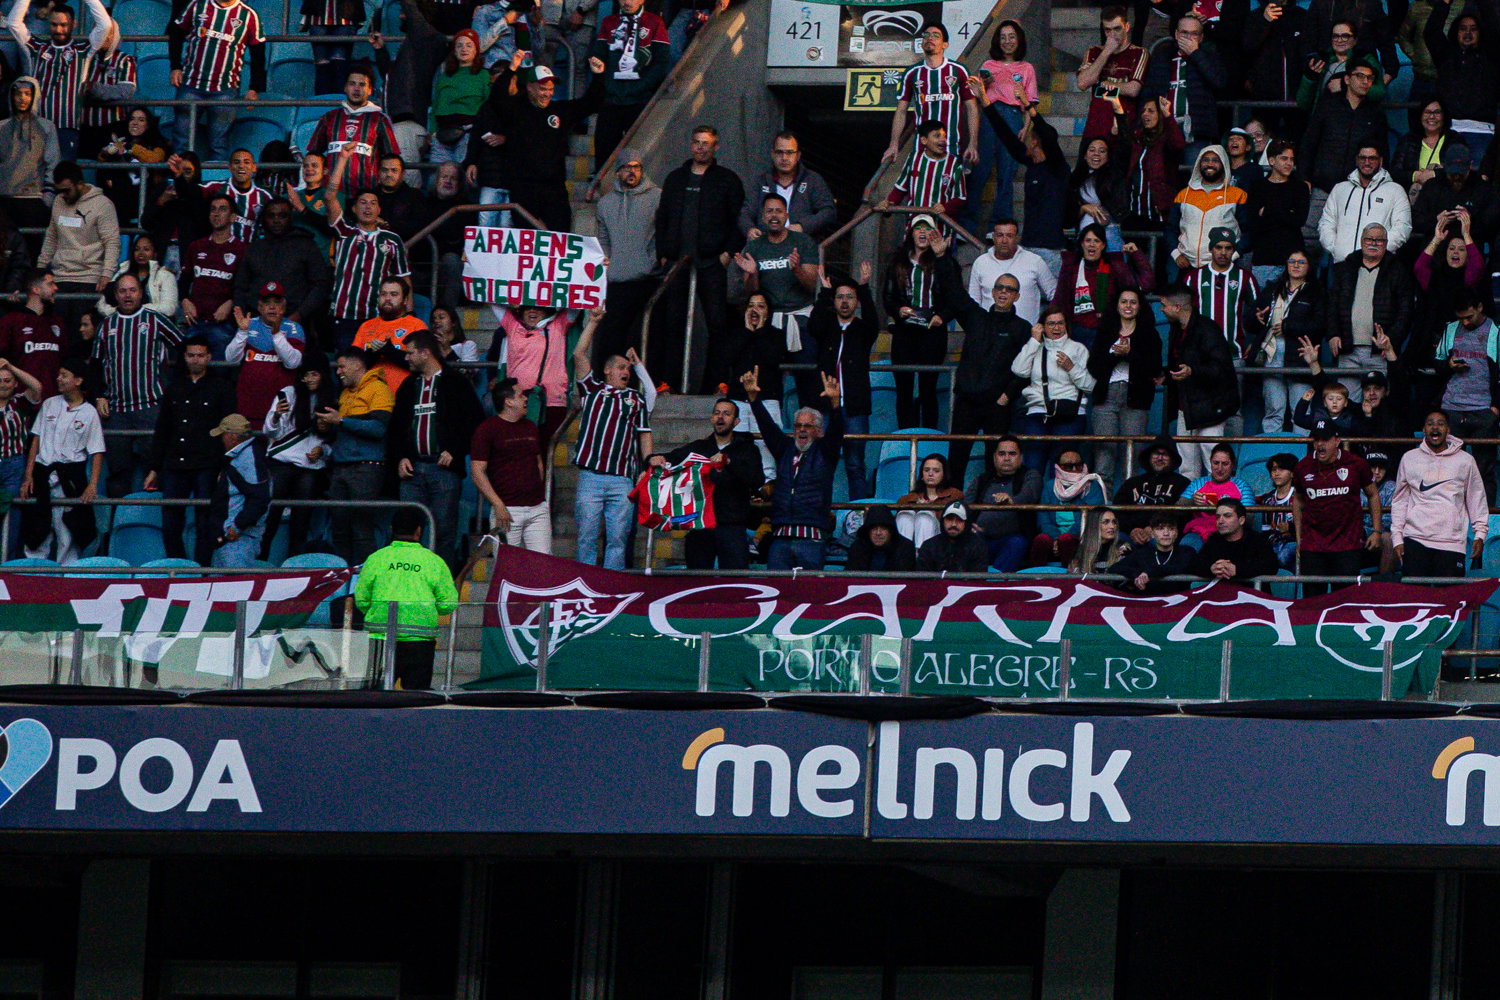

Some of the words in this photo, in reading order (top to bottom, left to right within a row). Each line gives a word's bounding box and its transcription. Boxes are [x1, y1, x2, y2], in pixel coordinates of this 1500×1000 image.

[785, 21, 822, 41] 421
[926, 93, 955, 103] BETANO
[464, 228, 583, 260] PARABENS
[517, 255, 573, 283] PAIS
[463, 276, 600, 310] TRICOLORES
[255, 352, 281, 362] BETAN
[1316, 486, 1350, 497] BETANO
[388, 561, 421, 573] APOIO
[759, 647, 900, 686] PORTO
[55, 737, 263, 812] POA
[695, 722, 1132, 823] melnick
